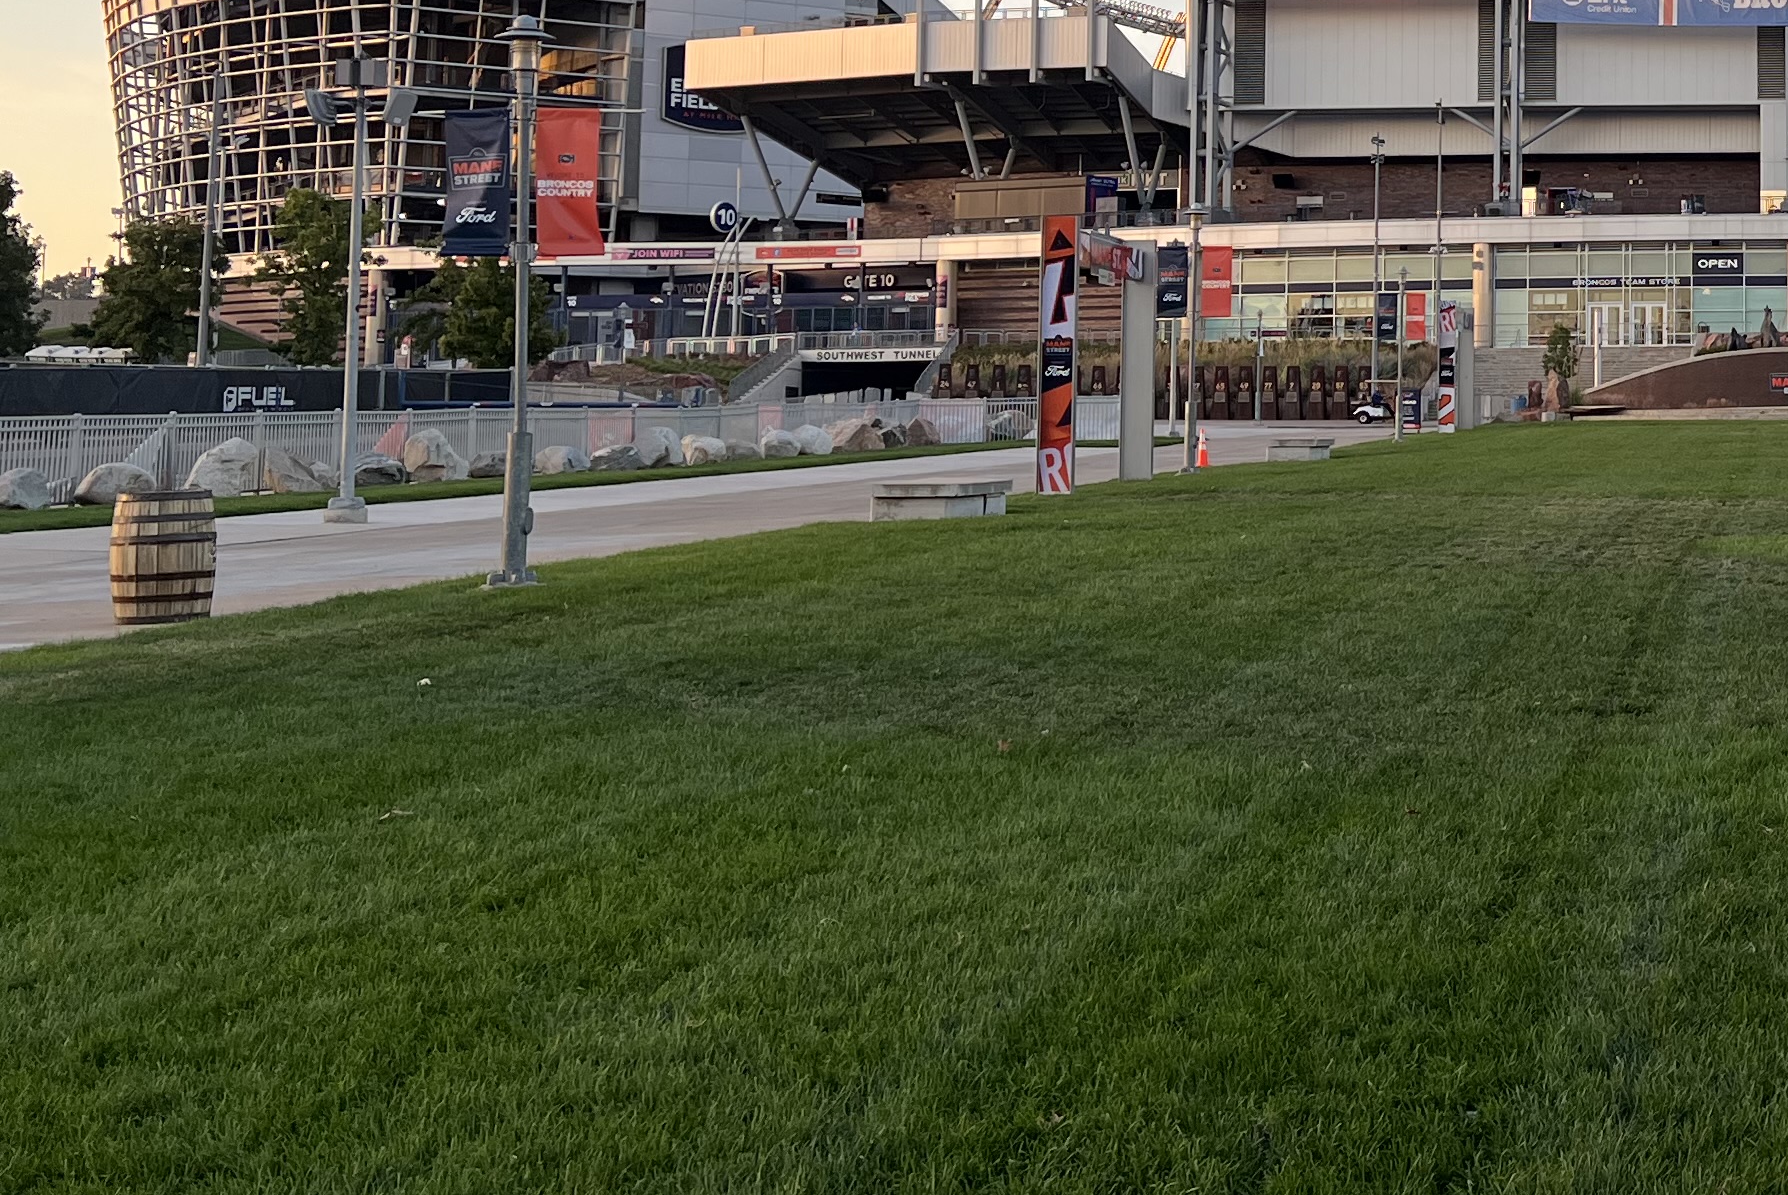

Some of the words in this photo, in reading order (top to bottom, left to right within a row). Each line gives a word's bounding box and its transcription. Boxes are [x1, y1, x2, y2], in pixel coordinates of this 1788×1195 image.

[1587, 5, 1612, 13] Credit
[1613, 5, 1637, 13] Union
[453, 173, 501, 186] STREET
[536, 179, 594, 189] BRONCOS
[537, 188, 594, 197] COUNTRY
[456, 206, 497, 223] Ford
[717, 209, 735, 226] 10
[632, 249, 657, 258] JOIN
[660, 249, 683, 258] WIFI
[1697, 259, 1738, 269] OPEN
[880, 274, 895, 287] 10
[1572, 278, 1617, 286] BRONCOS
[816, 350, 885, 361] SOUTHWEST
[894, 350, 938, 359] TUNNEL
[1044, 364, 1071, 377] Ford
